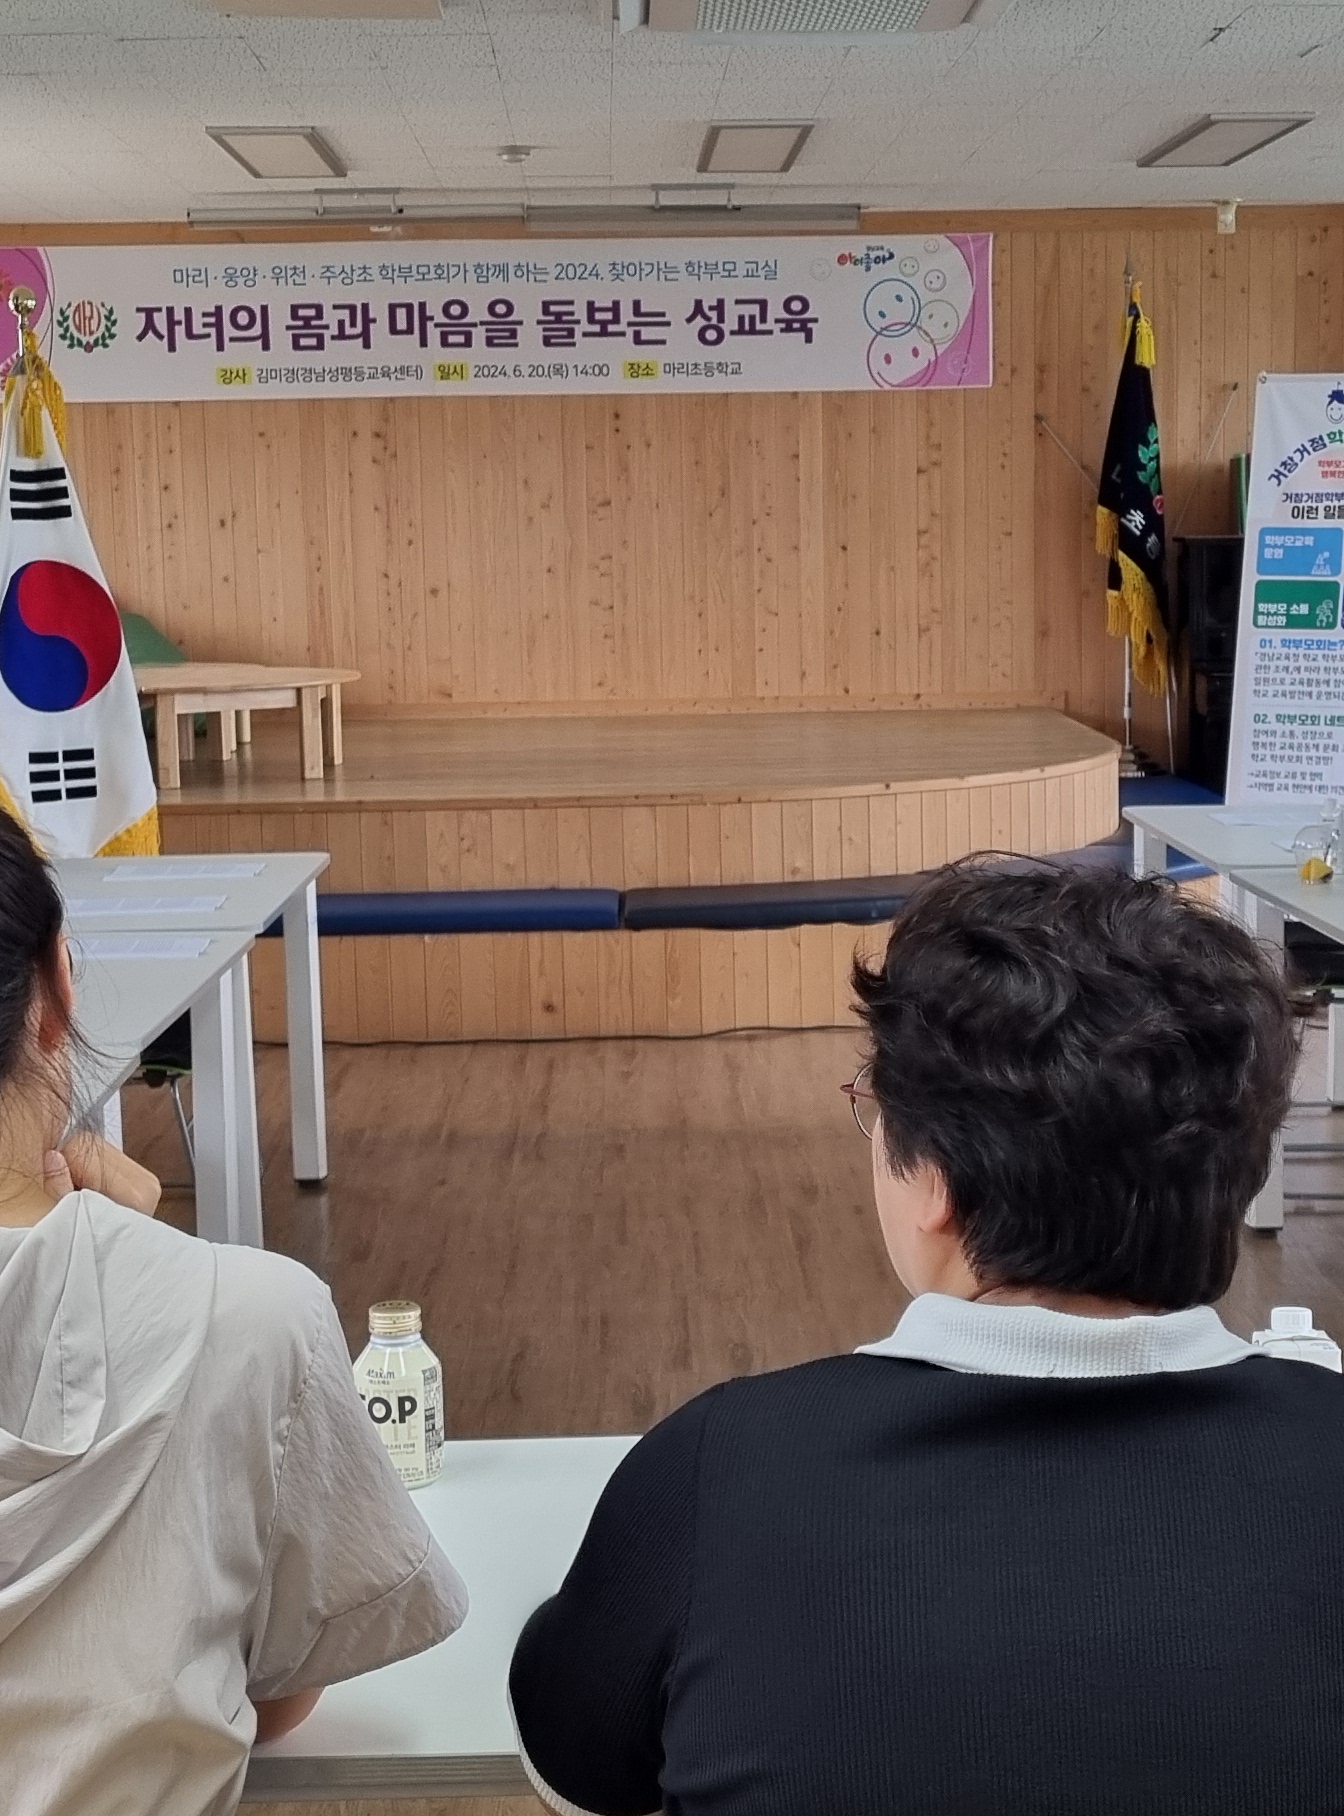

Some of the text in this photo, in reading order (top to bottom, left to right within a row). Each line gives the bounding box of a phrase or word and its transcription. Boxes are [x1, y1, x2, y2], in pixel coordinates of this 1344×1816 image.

[378, 262, 469, 285] 학부모회가
[473, 262, 509, 284] 함께
[513, 262, 550, 283] 하는
[554, 263, 604, 281] 2024.
[608, 261, 681, 282] 찾아가는
[684, 260, 739, 281] 학부모
[742, 259, 778, 281] 교실
[135, 294, 820, 352] 자녀의 몸과 마음을 돌보는 성교육
[220, 368, 248, 385] 강사
[437, 364, 465, 380] 일시
[573, 362, 610, 378] 14:00
[627, 361, 655, 378] 장소
[663, 361, 743, 378] 마리초등학교
[1291, 505, 1319, 520] 이런
[1257, 603, 1287, 615] 학부모
[1259, 639, 1277, 650] 01.
[1253, 713, 1272, 725] 02.
[1275, 713, 1321, 726] 학부모회
